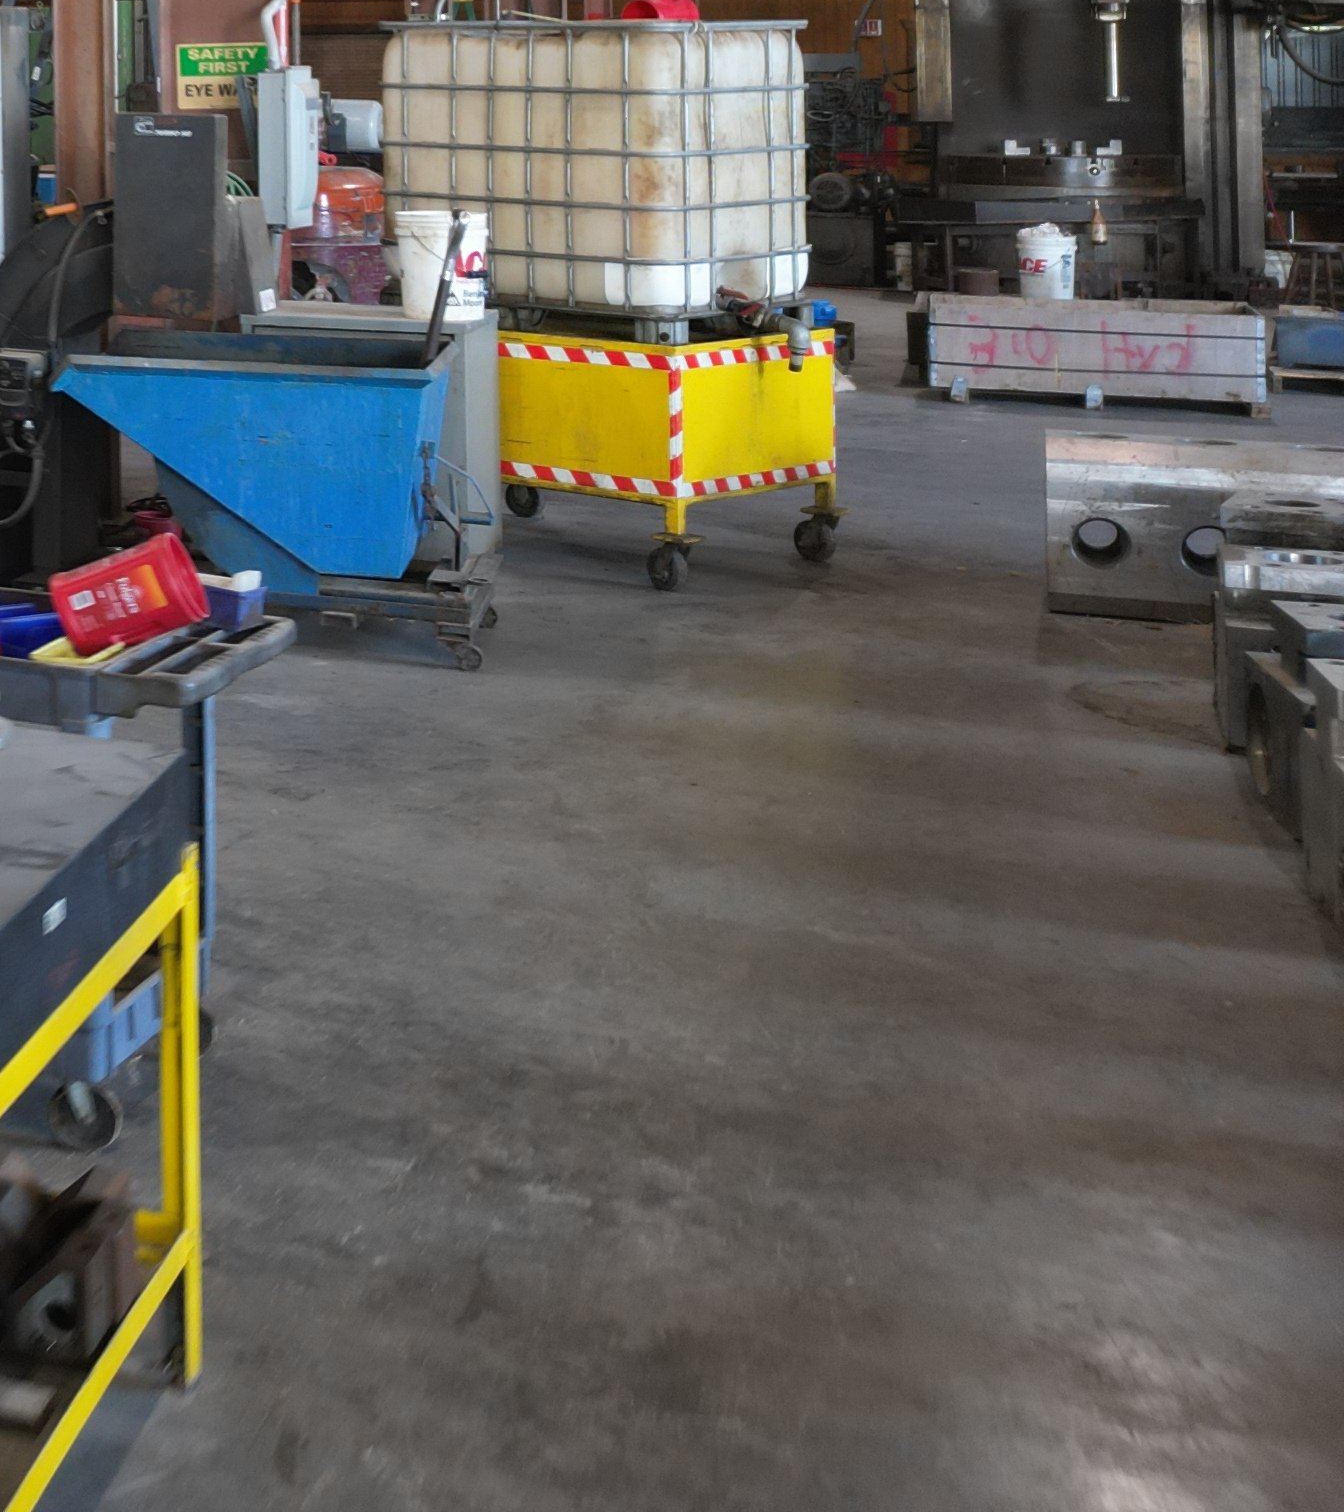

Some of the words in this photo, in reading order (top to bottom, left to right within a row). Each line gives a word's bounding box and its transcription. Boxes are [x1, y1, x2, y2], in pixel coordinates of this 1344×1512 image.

[187, 47, 258, 61] SAFETY
[198, 60, 250, 74] FIRST
[185, 84, 213, 97] EYE
